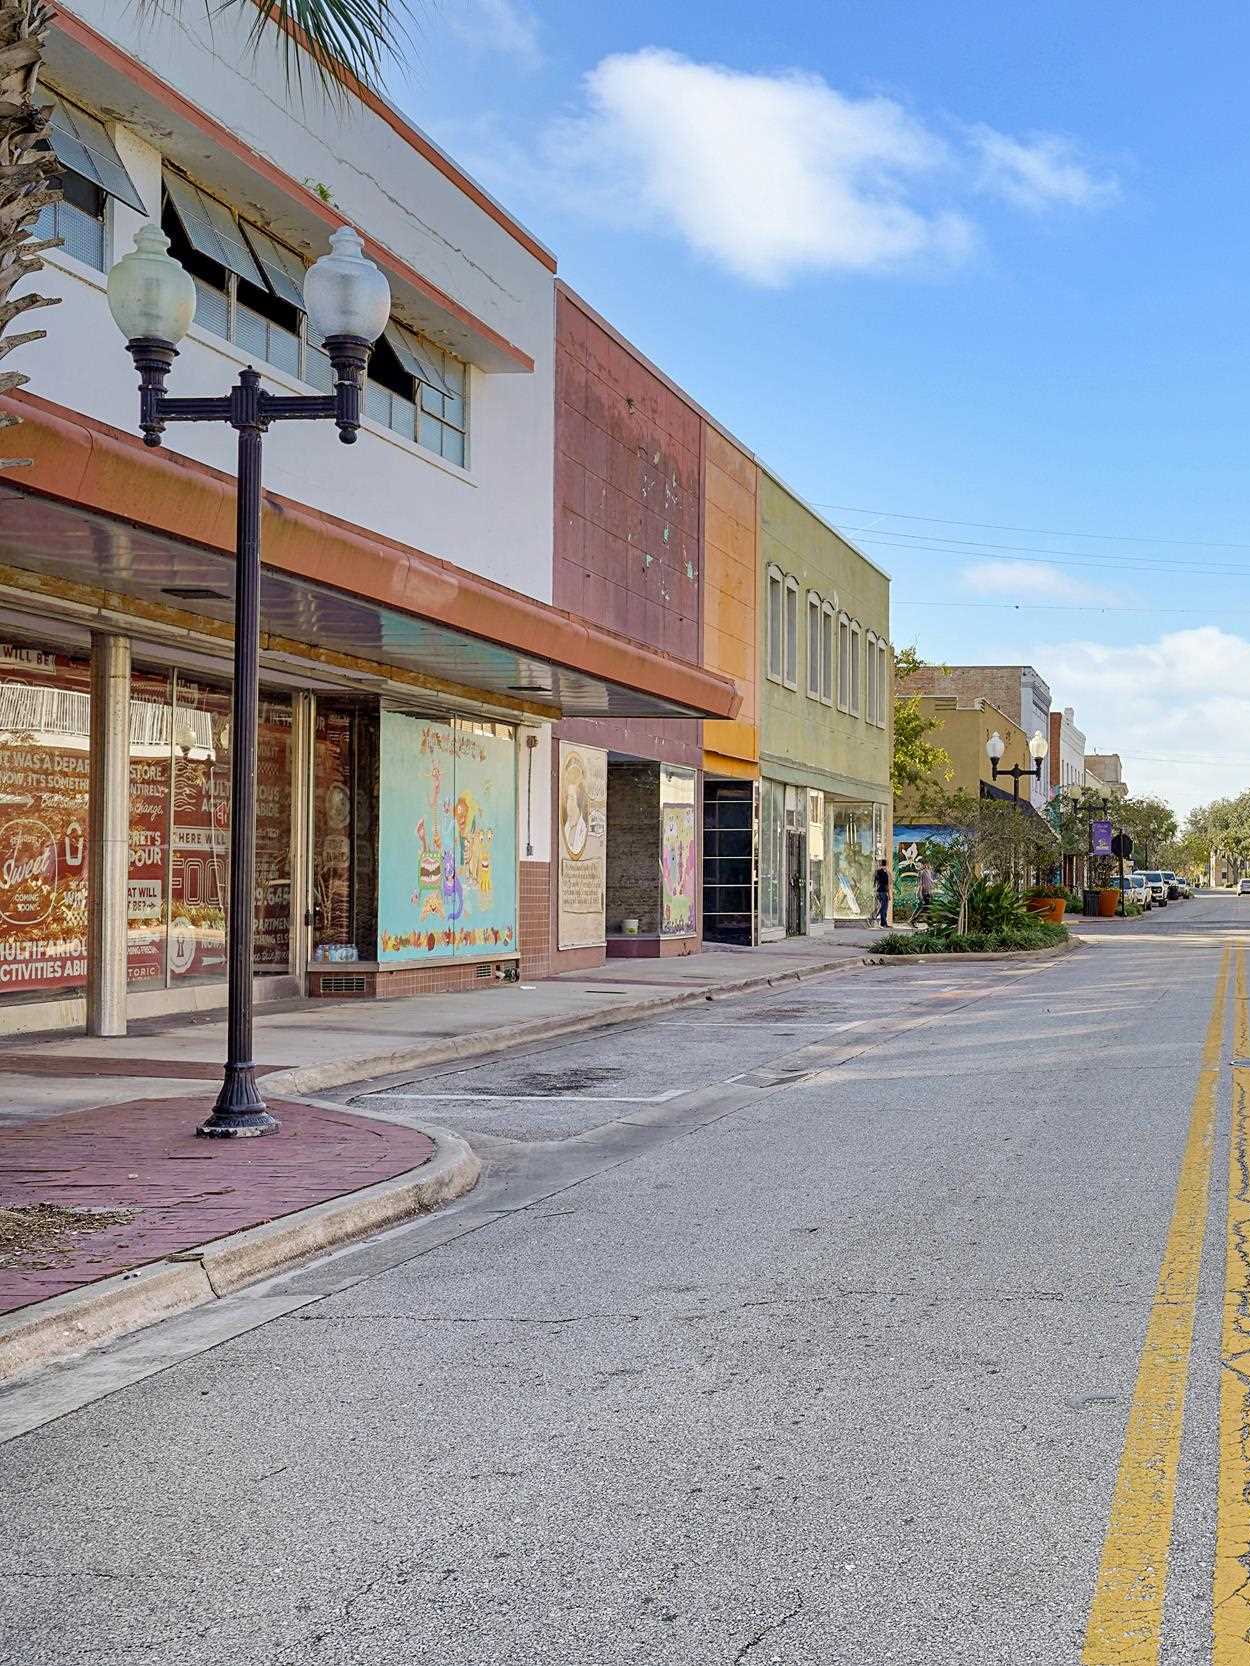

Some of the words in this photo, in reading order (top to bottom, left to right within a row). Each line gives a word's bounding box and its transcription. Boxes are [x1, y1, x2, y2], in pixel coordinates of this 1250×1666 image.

[3, 645, 32, 663] WILL
[178, 832, 202, 844] HERE
[206, 833, 226, 845] WILL
[138, 888, 157, 898] WILL
